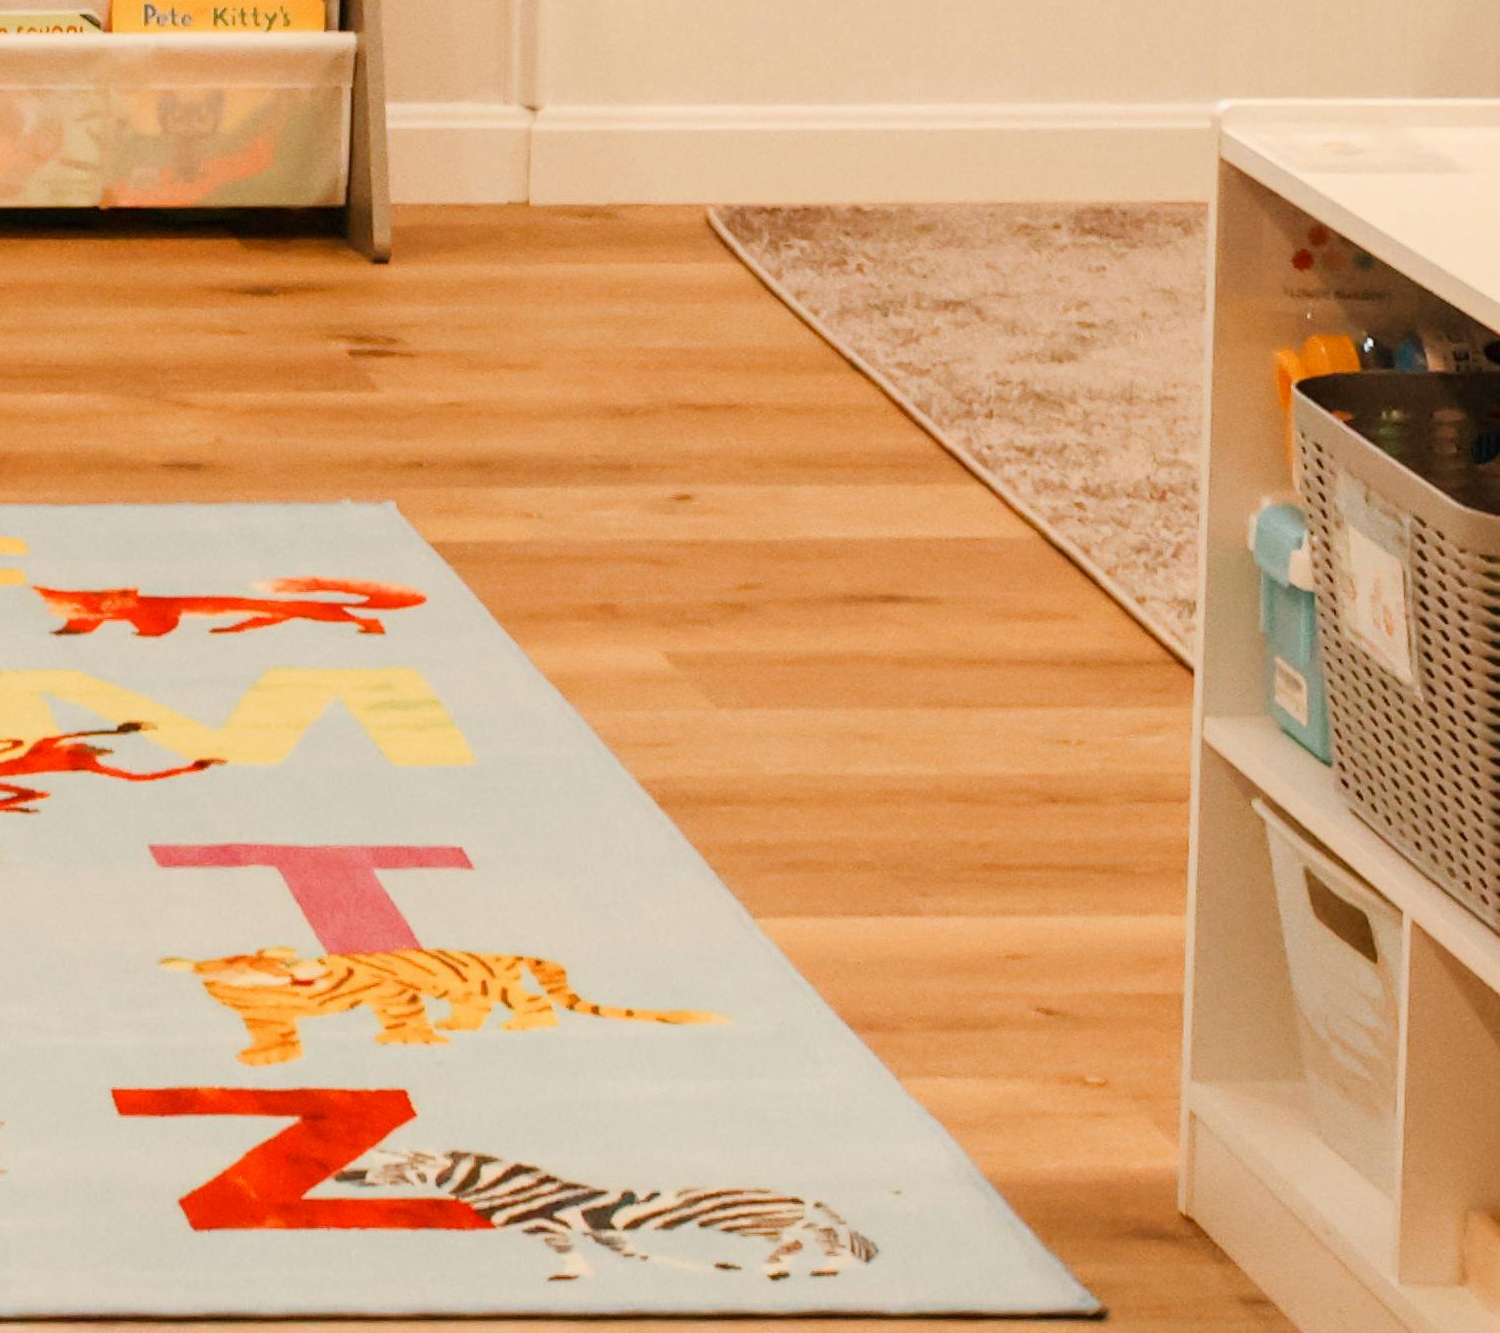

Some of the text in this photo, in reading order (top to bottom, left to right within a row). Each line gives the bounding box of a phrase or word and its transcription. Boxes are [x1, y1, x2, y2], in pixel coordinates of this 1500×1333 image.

[142, 3, 193, 28] Pete
[148, 843, 475, 953] T
[111, 1088, 497, 1230] Z
